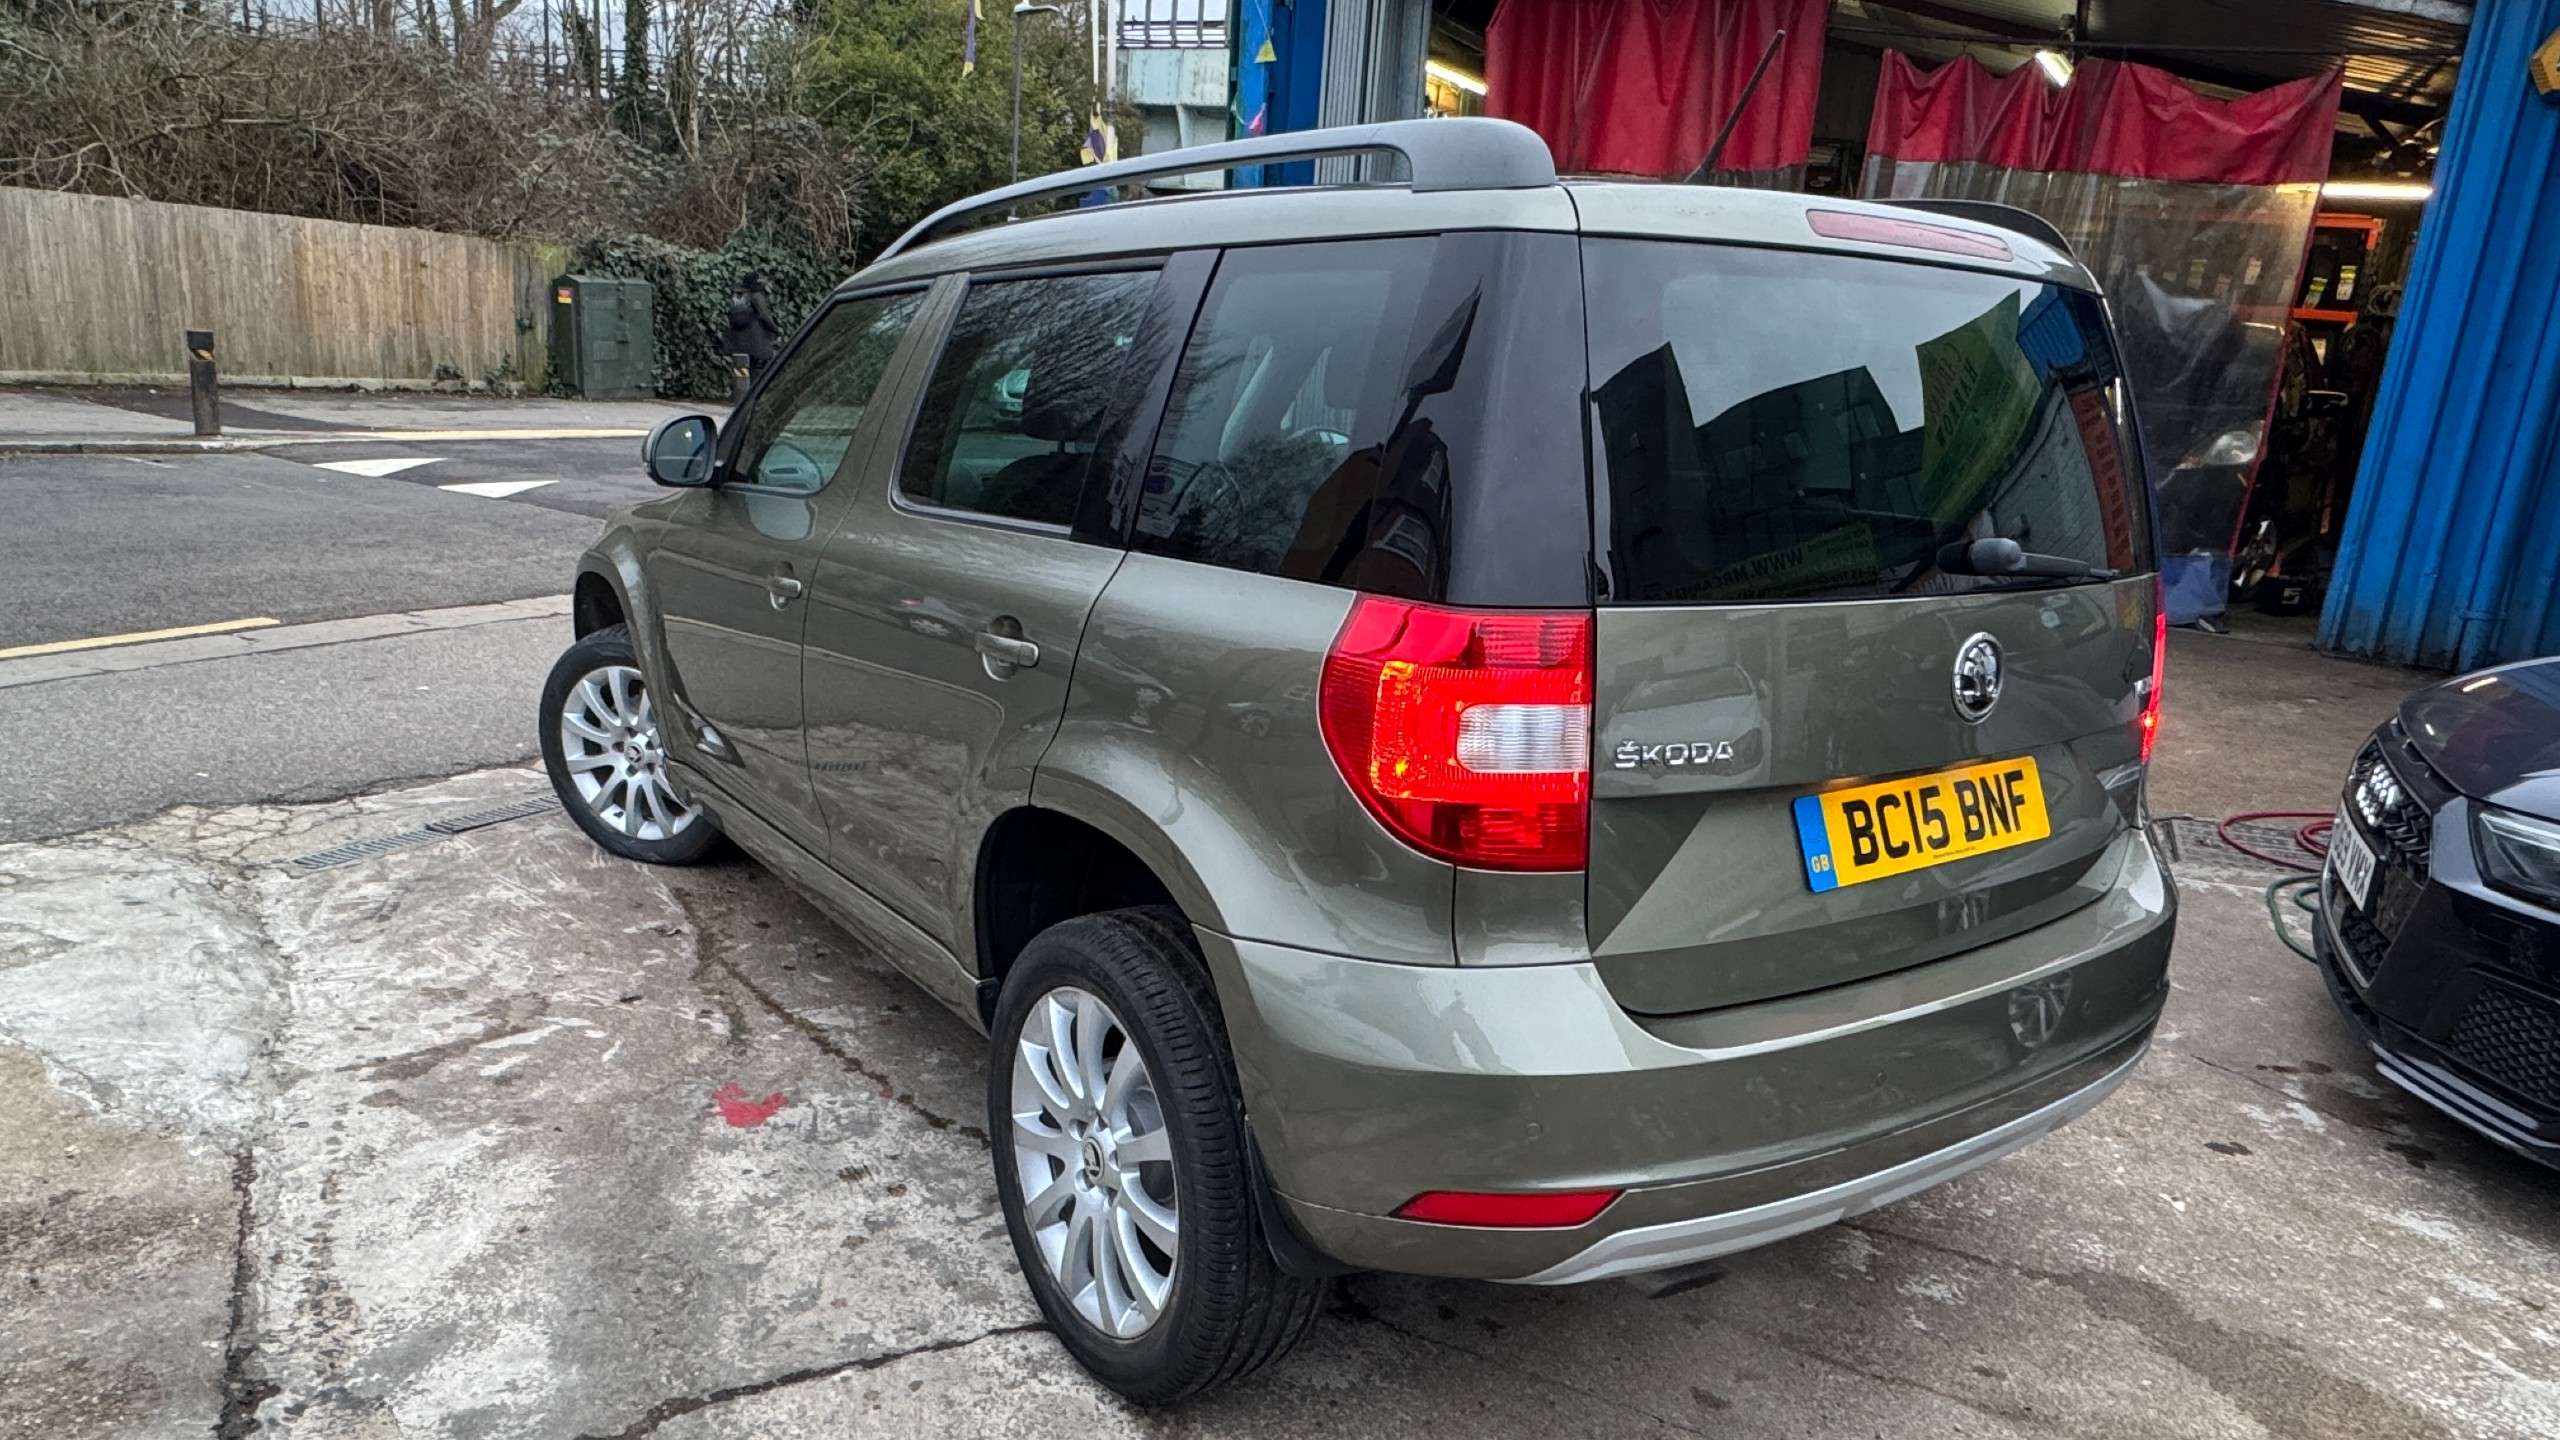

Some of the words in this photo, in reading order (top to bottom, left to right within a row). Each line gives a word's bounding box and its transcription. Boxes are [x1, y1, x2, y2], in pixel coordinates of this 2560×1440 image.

[1614, 740, 1734, 768] ŠKODA
[1842, 785, 1951, 867] BC15
[1953, 769, 2026, 843] BNF
[1811, 853, 1830, 873] GB
